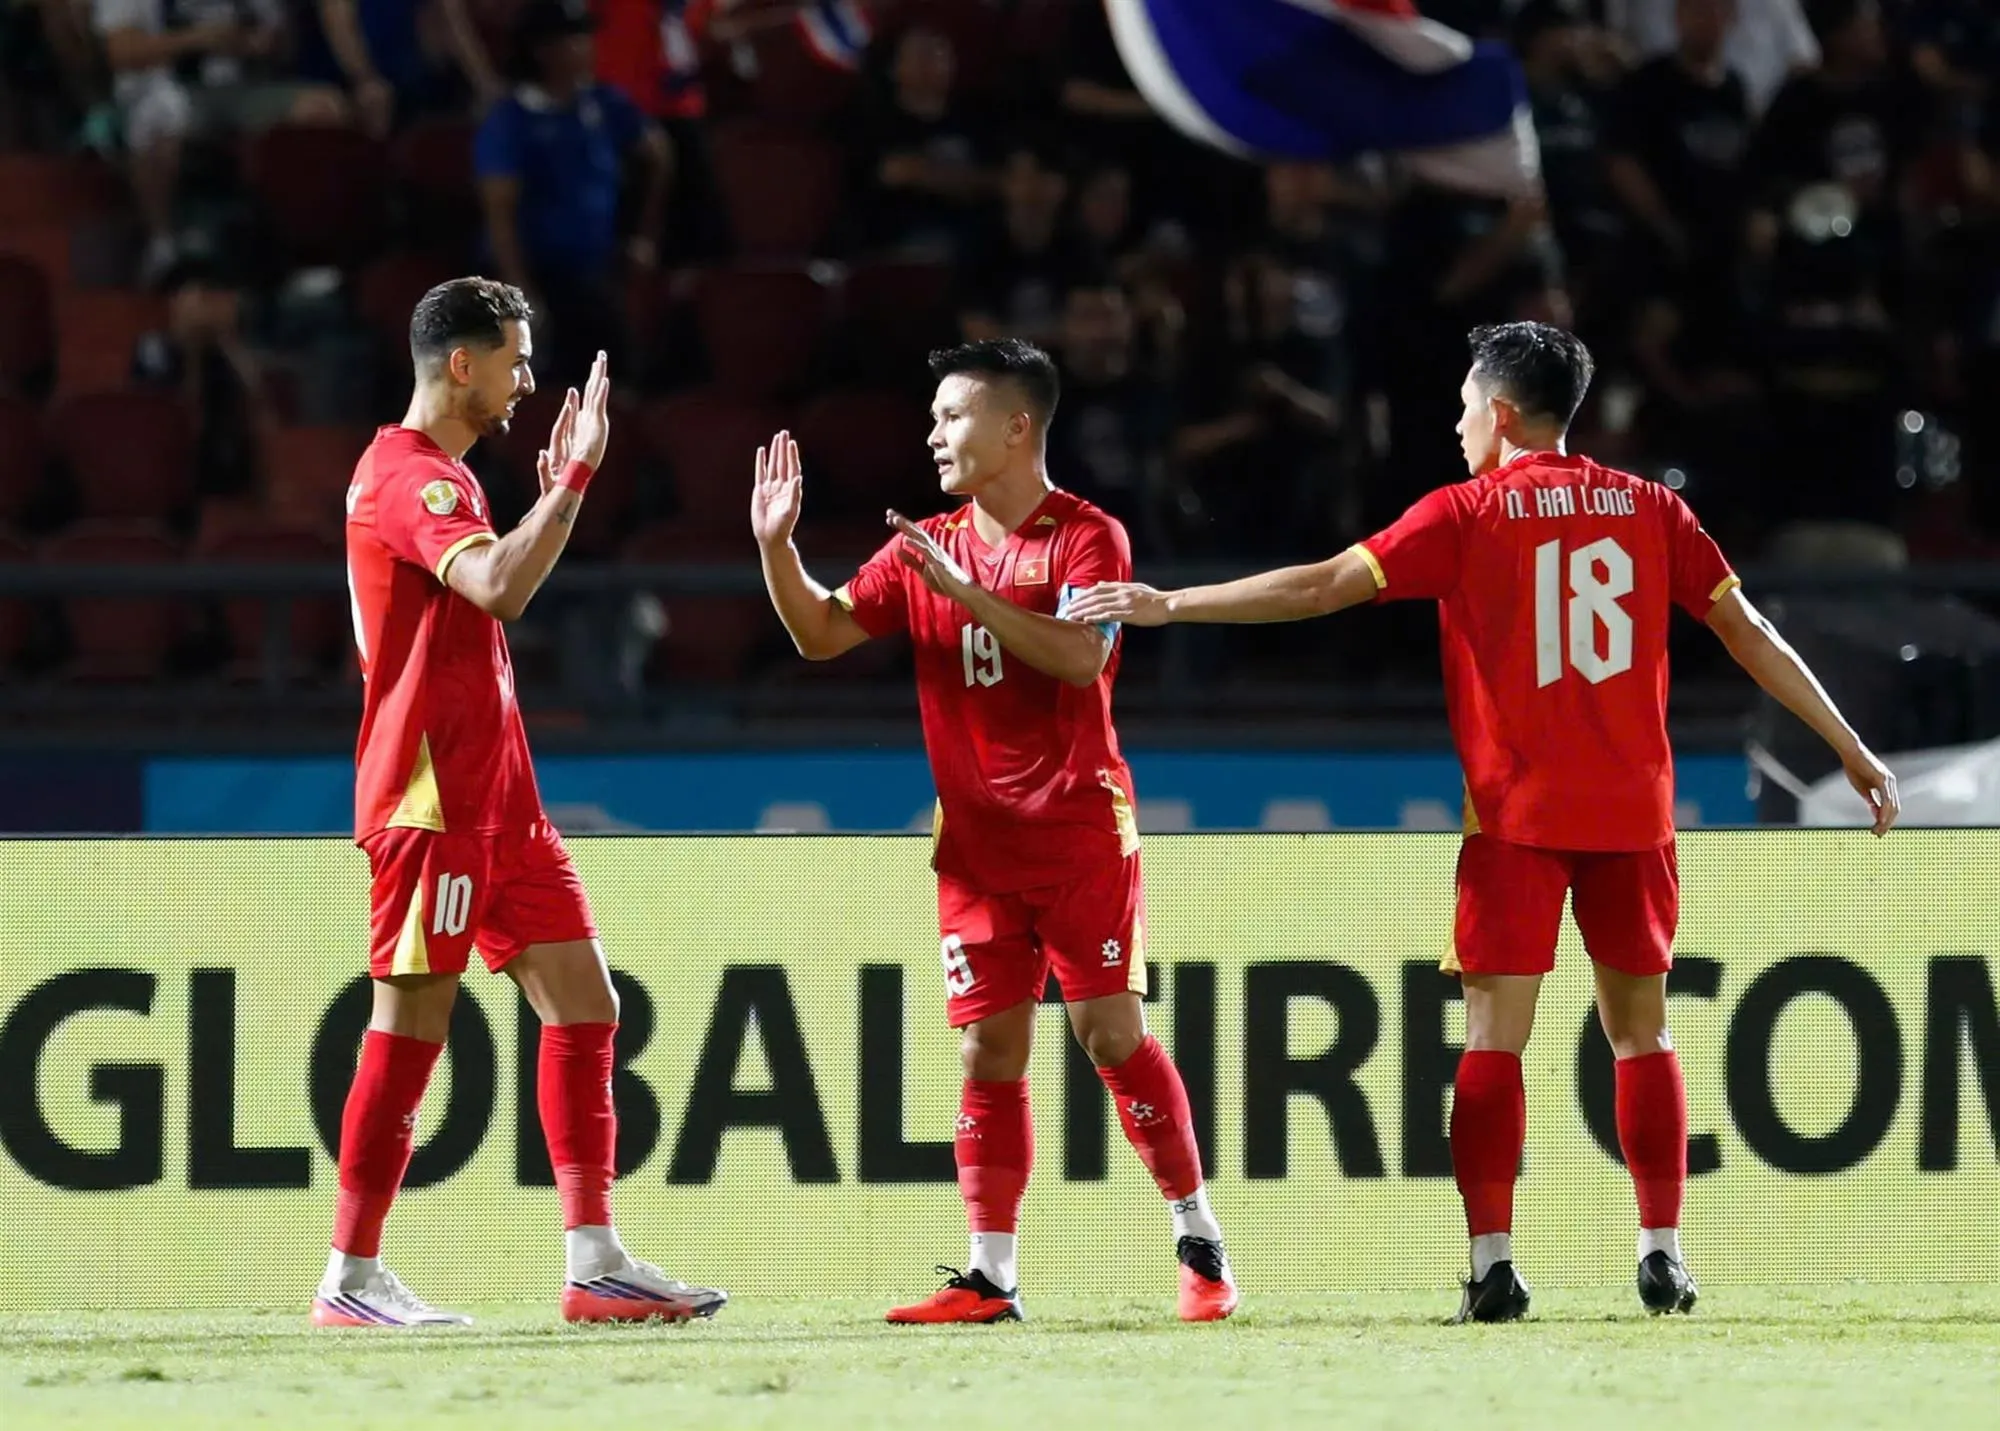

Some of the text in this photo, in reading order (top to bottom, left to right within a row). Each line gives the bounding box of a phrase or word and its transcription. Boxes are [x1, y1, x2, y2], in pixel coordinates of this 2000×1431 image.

[1535, 485, 1576, 518] HAI
[1535, 536, 1634, 689] 18
[962, 622, 1004, 688] 19
[432, 871, 473, 937] 10
